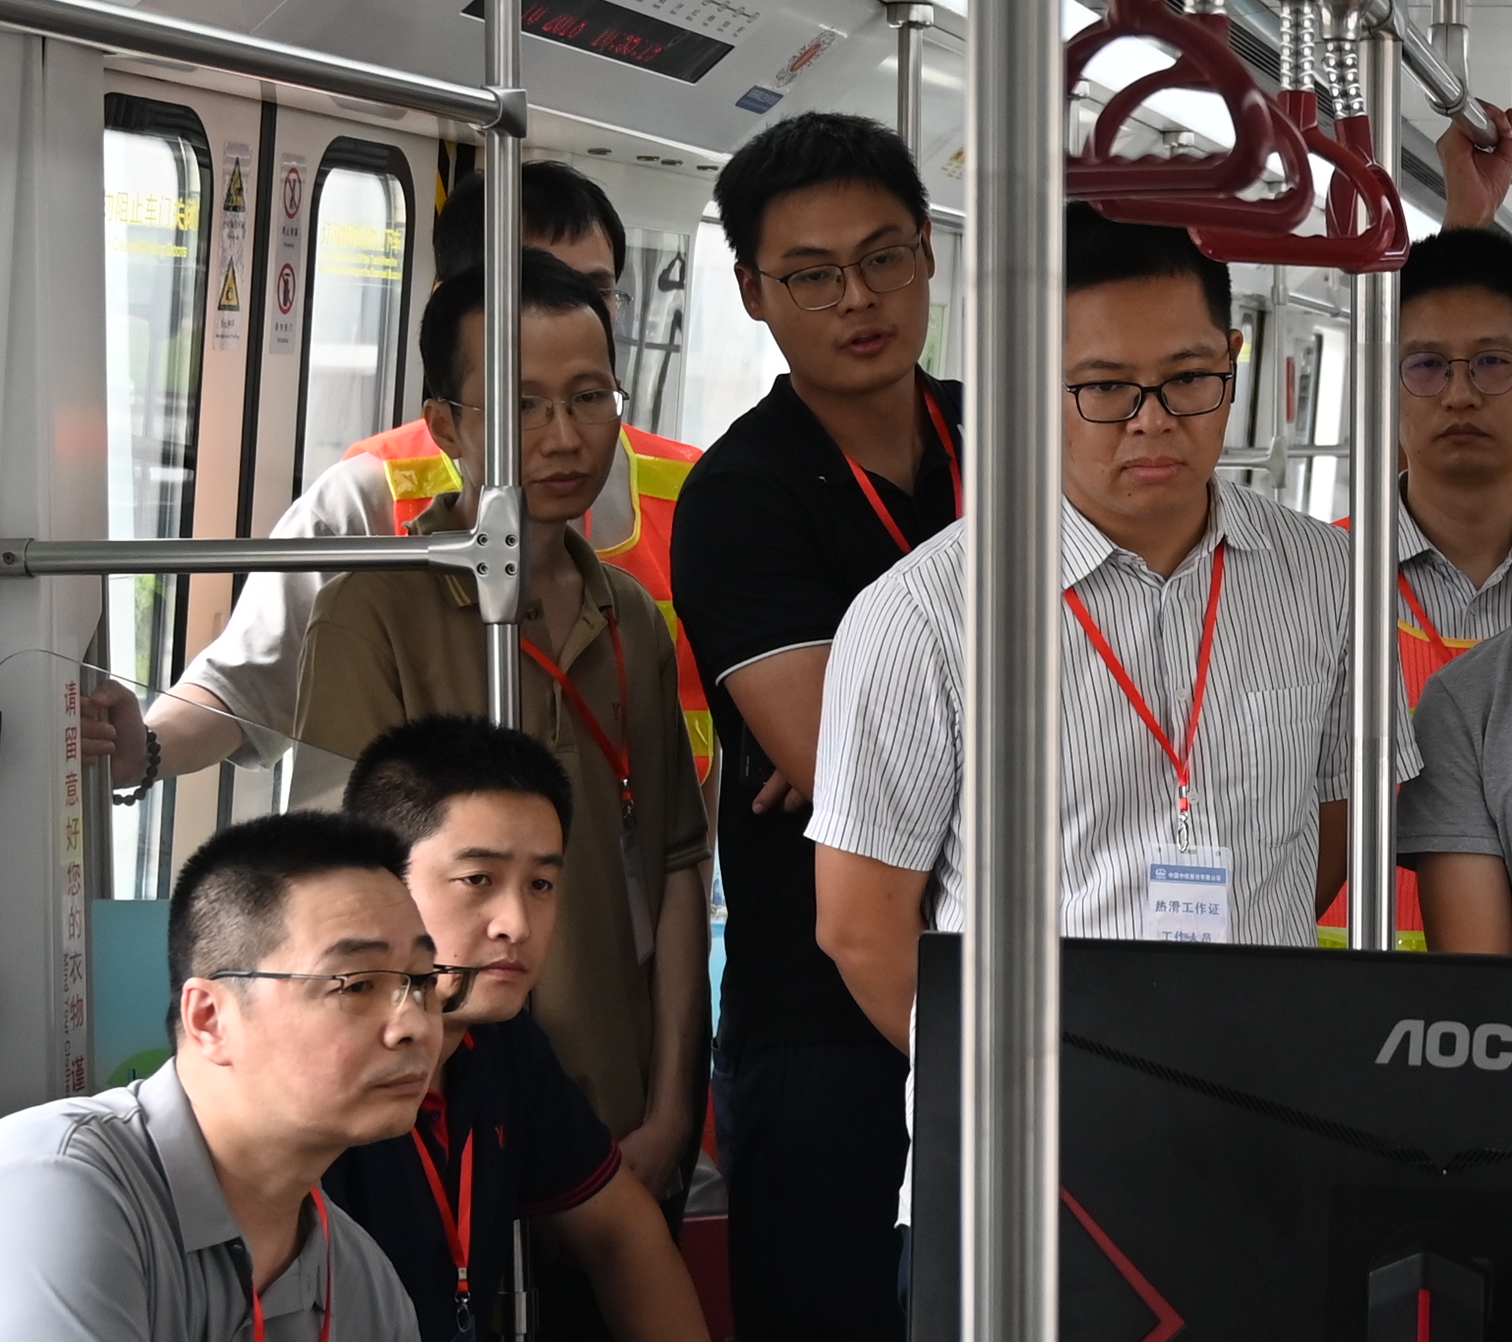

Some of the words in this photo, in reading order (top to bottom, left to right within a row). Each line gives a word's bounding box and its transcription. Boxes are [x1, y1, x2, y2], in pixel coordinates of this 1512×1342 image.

[1155, 899, 1220, 916] 热滑工作证
